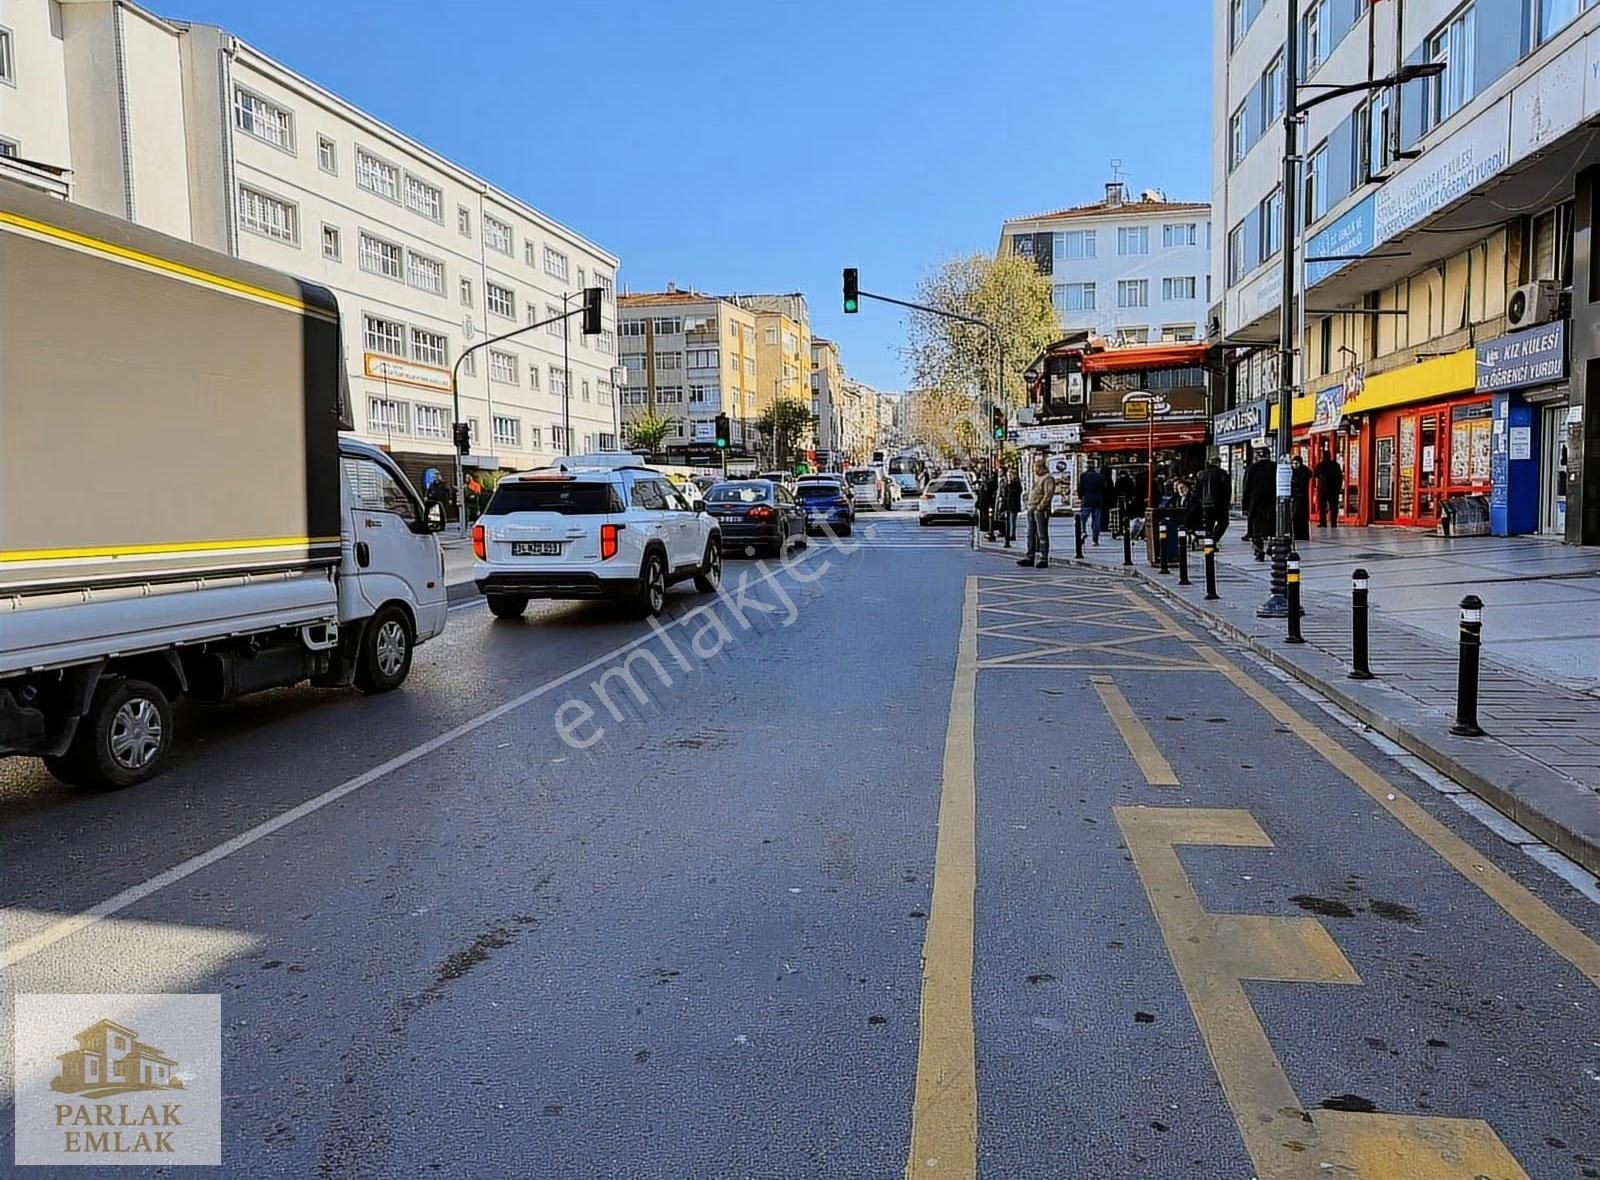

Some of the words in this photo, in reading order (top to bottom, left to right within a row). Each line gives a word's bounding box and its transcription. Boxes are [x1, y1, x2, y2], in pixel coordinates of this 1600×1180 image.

[1475, 147, 1506, 183] YURDU
[1503, 342, 1520, 361] KIZ
[1521, 327, 1559, 357] KULESİ
[1489, 361, 1528, 387] ÖĞRENCİ
[1529, 358, 1562, 379] YURDU
